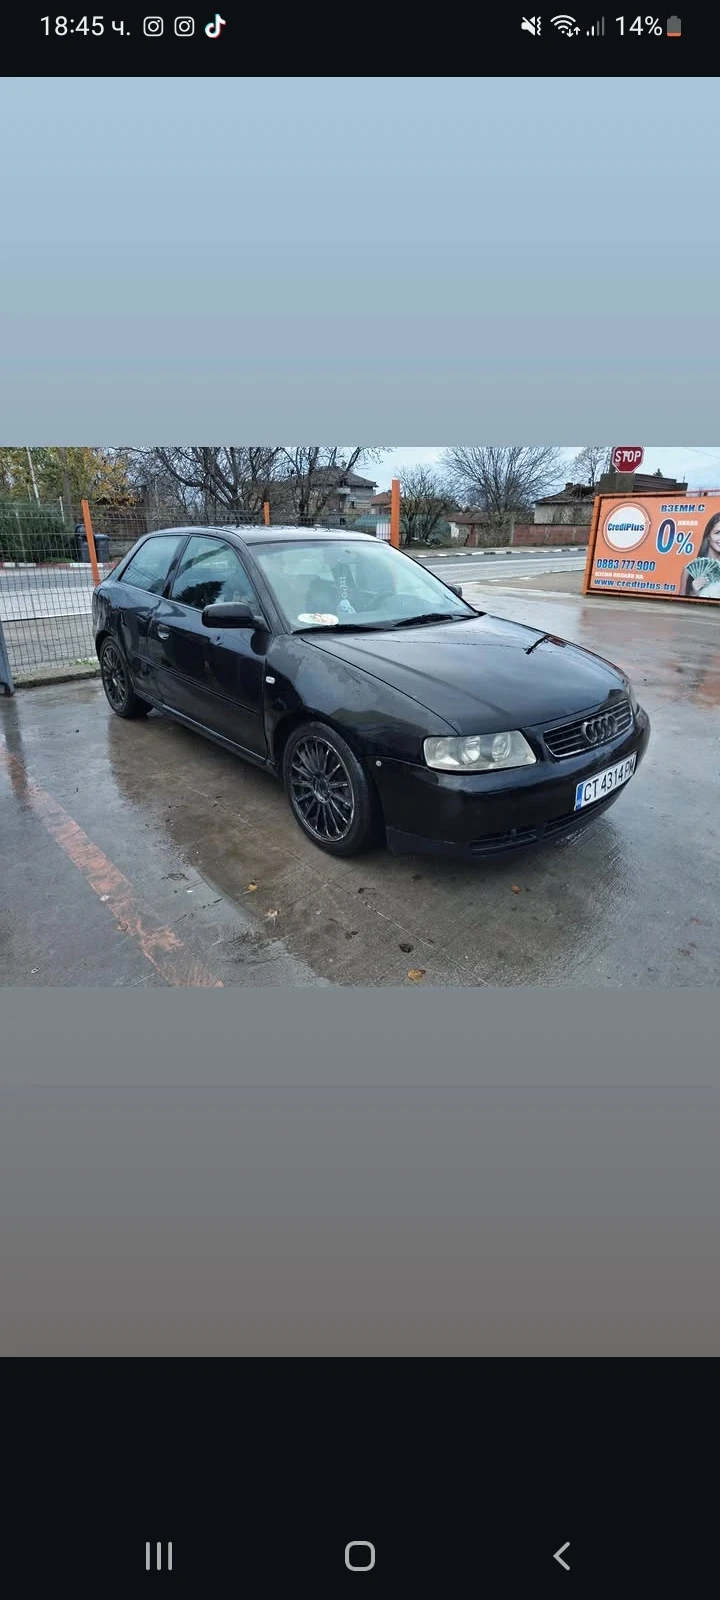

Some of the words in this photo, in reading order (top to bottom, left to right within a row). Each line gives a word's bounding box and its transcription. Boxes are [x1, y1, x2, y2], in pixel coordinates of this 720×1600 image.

[615, 450, 641, 462] STOP
[661, 504, 696, 513] ВЗЕМИ
[607, 523, 645, 532] CrediPlus
[657, 518, 694, 555] 0%
[597, 559, 619, 570] 0883
[621, 559, 635, 570] 777
[636, 560, 656, 571] 900
[594, 579, 676, 592] www.crediplus.bg
[584, 778, 599, 802] CT
[601, 765, 624, 792] 4314
